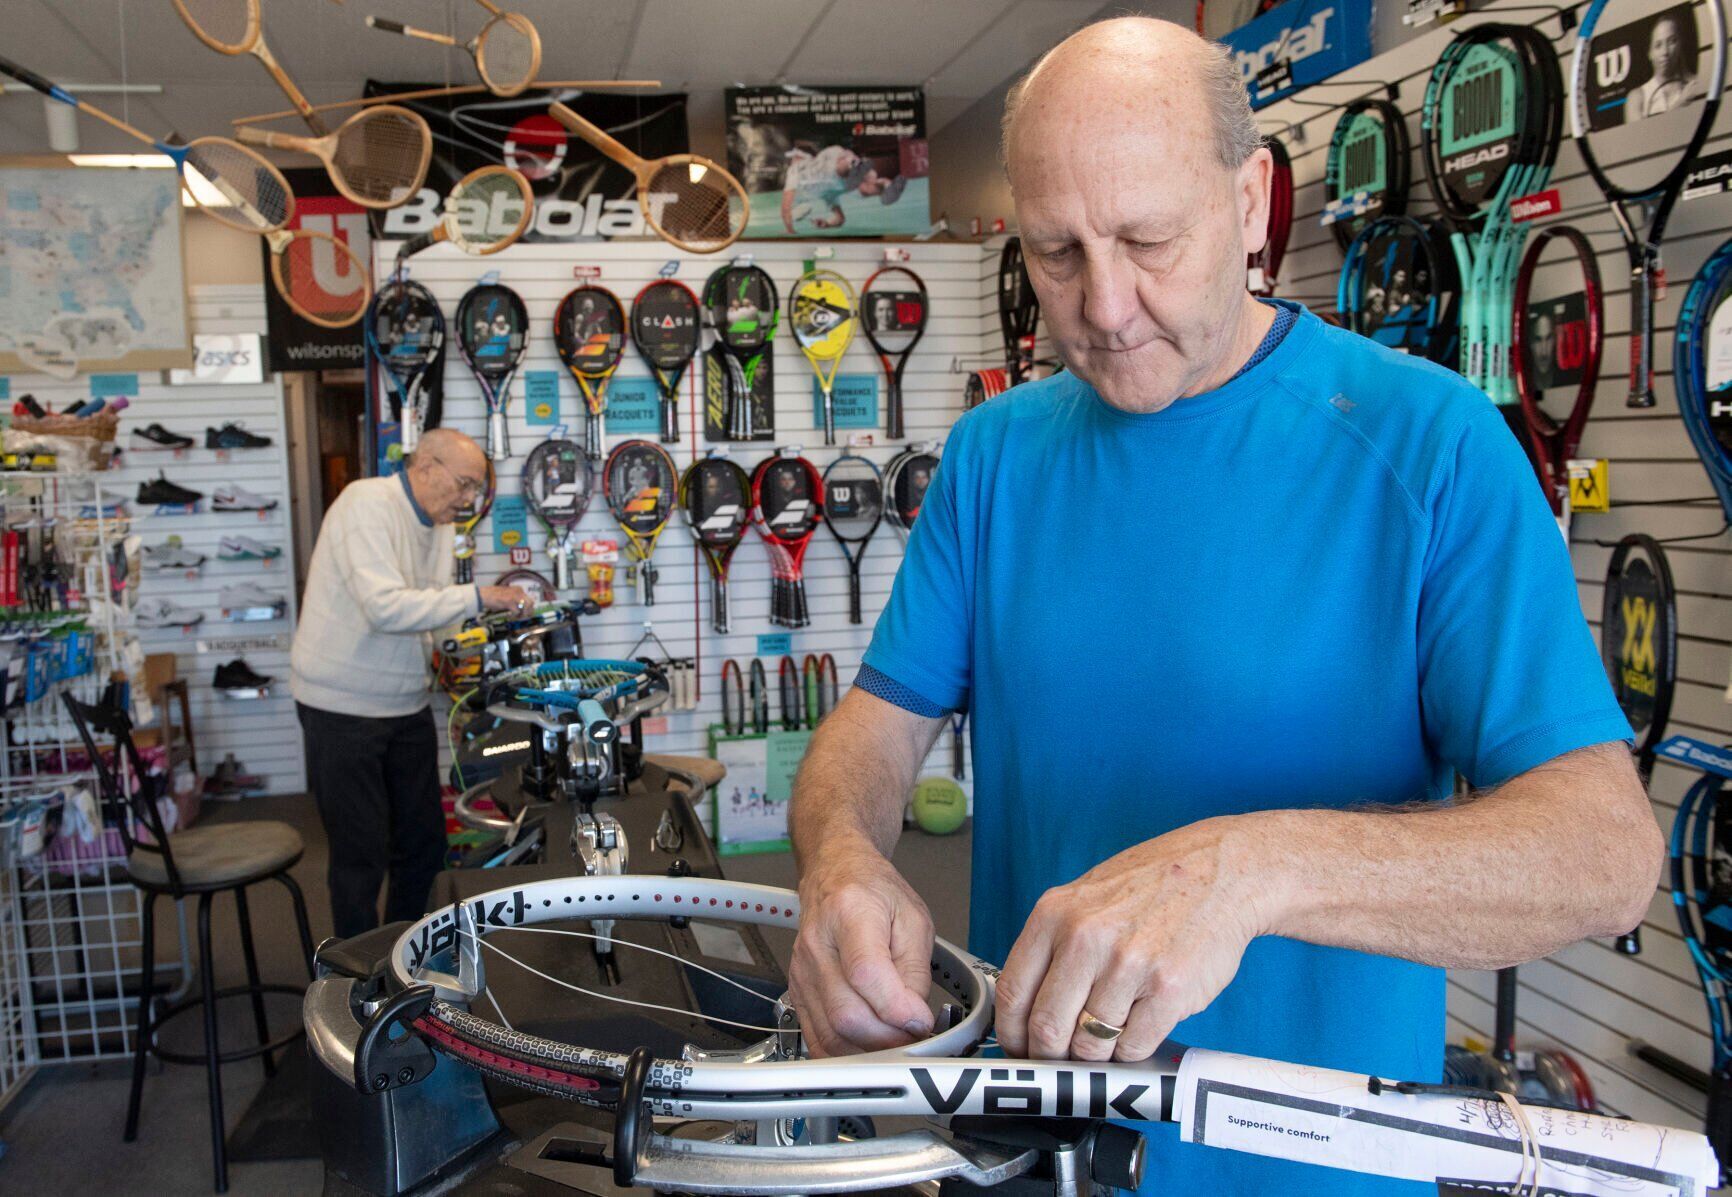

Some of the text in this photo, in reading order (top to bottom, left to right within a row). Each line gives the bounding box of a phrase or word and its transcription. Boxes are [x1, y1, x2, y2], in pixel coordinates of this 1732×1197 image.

[815, 114, 842, 123] Tennis
[1444, 142, 1510, 175] HEAD
[1511, 198, 1552, 219] Wilson
[612, 391, 646, 402] JUNIOR
[410, 890, 525, 969] Vökl
[909, 1067, 1174, 1121] Völkl
[1227, 1115, 1330, 1143] Supportive comfort
